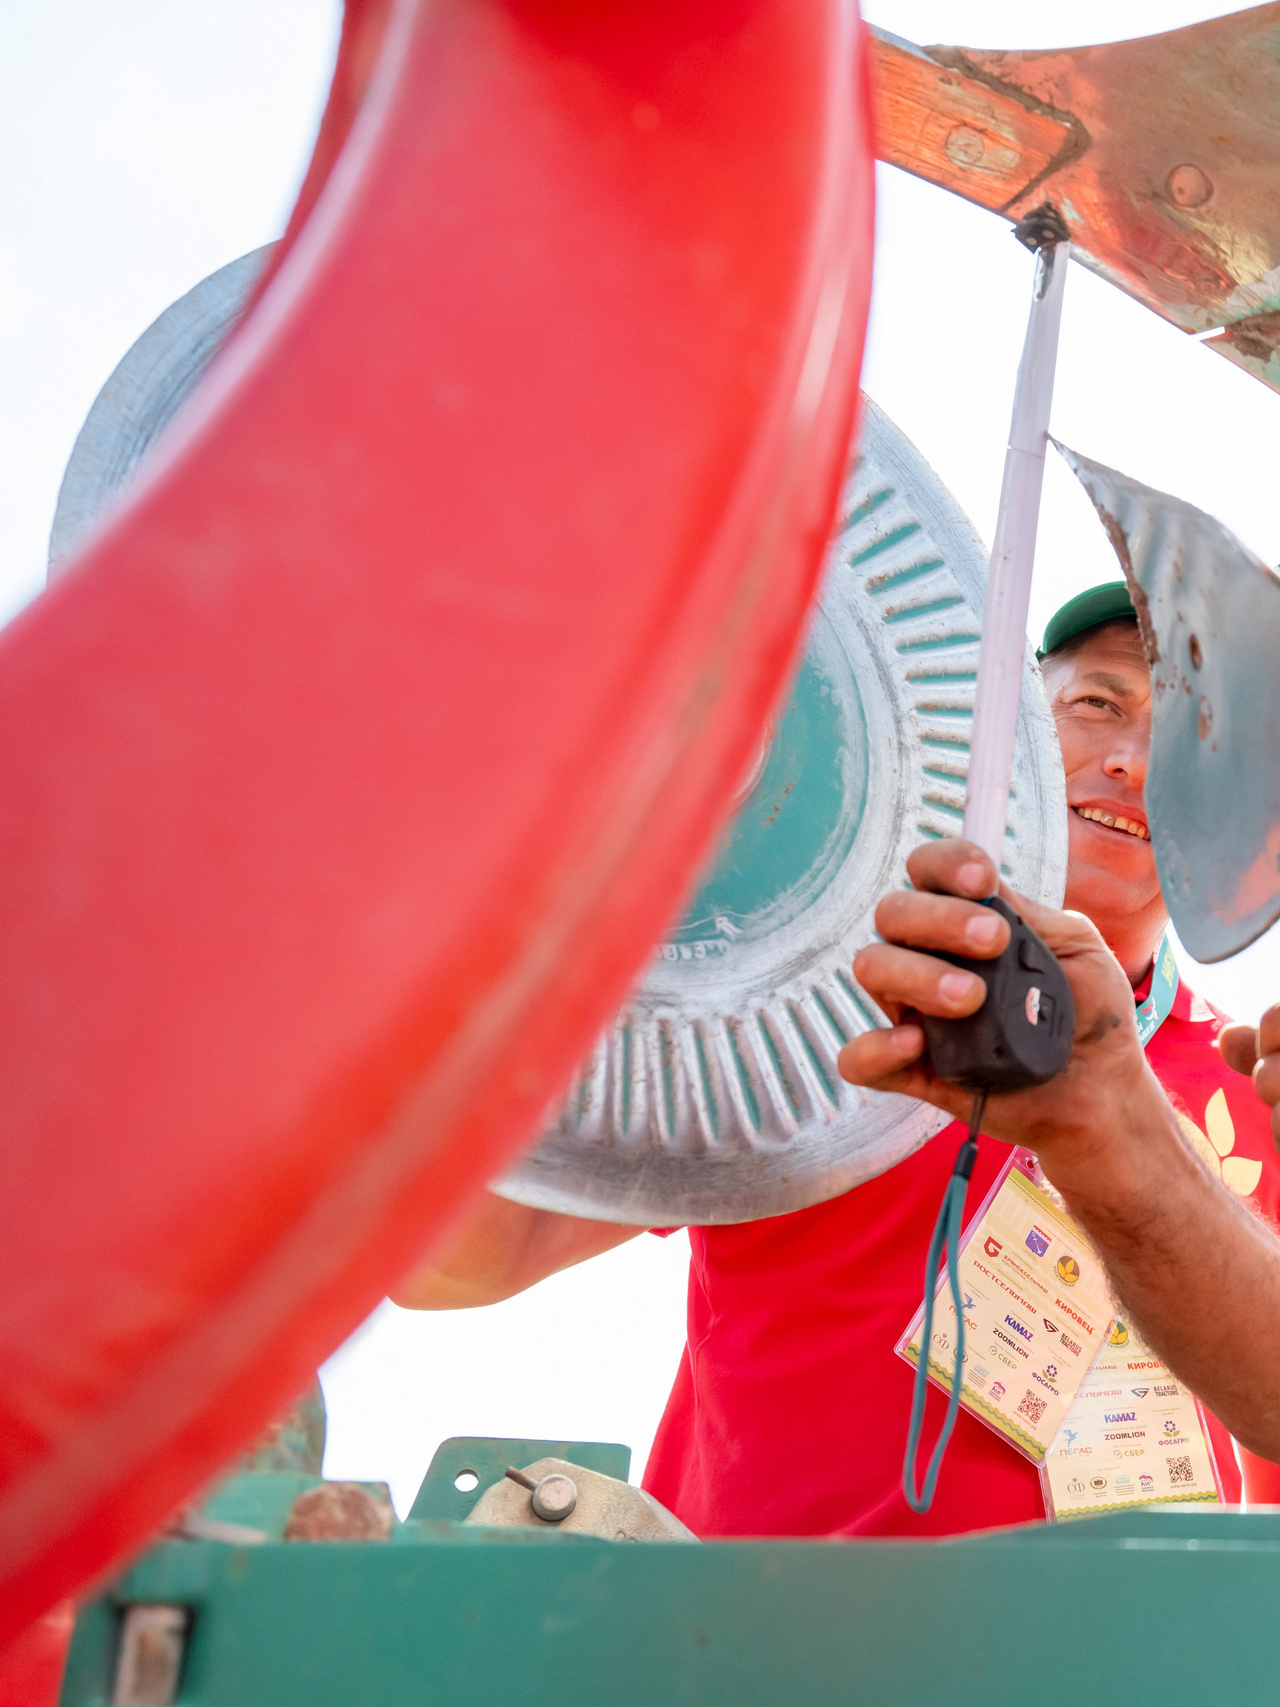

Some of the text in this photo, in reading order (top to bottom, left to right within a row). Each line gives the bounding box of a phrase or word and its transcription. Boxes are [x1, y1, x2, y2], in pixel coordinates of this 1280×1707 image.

[973, 1260, 1037, 1314] РОСТСЕЛЬМАШ
[949, 1304, 977, 1330] ПАС
[1055, 1298, 1094, 1335] КИРОВЕЦ
[1004, 1314, 1034, 1342] KAMAZ
[993, 1327, 1029, 1359] ZOOMLION
[1059, 1339, 1080, 1357] TRACTORS
[1061, 1333, 1082, 1353] BELARUS
[998, 1353, 1018, 1370] СБЕР
[1127, 1360, 1165, 1370] КИРОВЕ
[1031, 1372, 1059, 1396] ФОСАГРО
[1153, 1384, 1177, 1392] BELARUS
[1073, 1389, 1122, 1399] СЕЛЬМАШ
[1104, 1411, 1137, 1423] KAMAZ
[1104, 1431, 1146, 1441] ZOOMLION
[1158, 1437, 1189, 1446] ФОСАГРО
[1059, 1447, 1093, 1457] ПЕГАС
[1124, 1449, 1145, 1457] СБЕР
